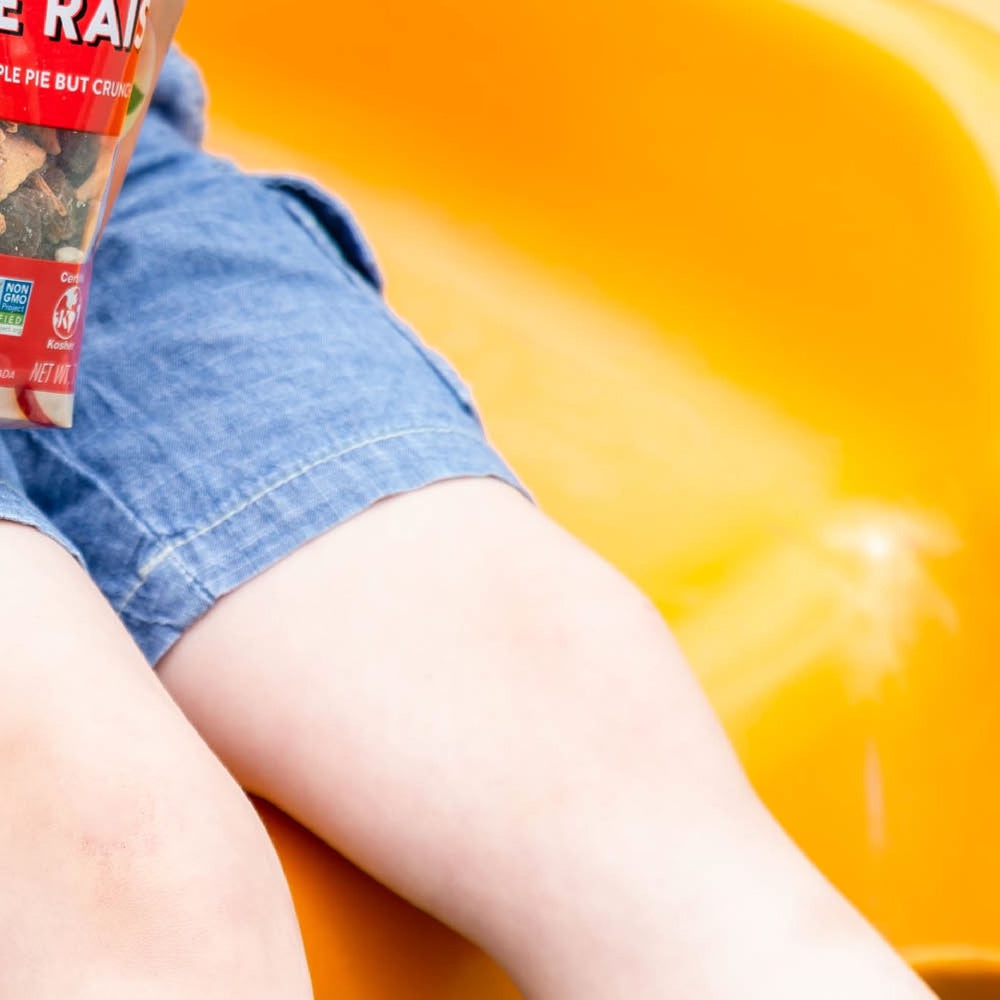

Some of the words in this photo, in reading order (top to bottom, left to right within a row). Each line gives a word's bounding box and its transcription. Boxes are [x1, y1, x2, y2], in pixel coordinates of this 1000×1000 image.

[25, 68, 51, 88] PIE
[55, 73, 90, 93] BUT
[5, 283, 29, 294] NON
[3, 293, 27, 304] GMO
[1, 303, 24, 313] Project
[29, 361, 54, 383] NET
